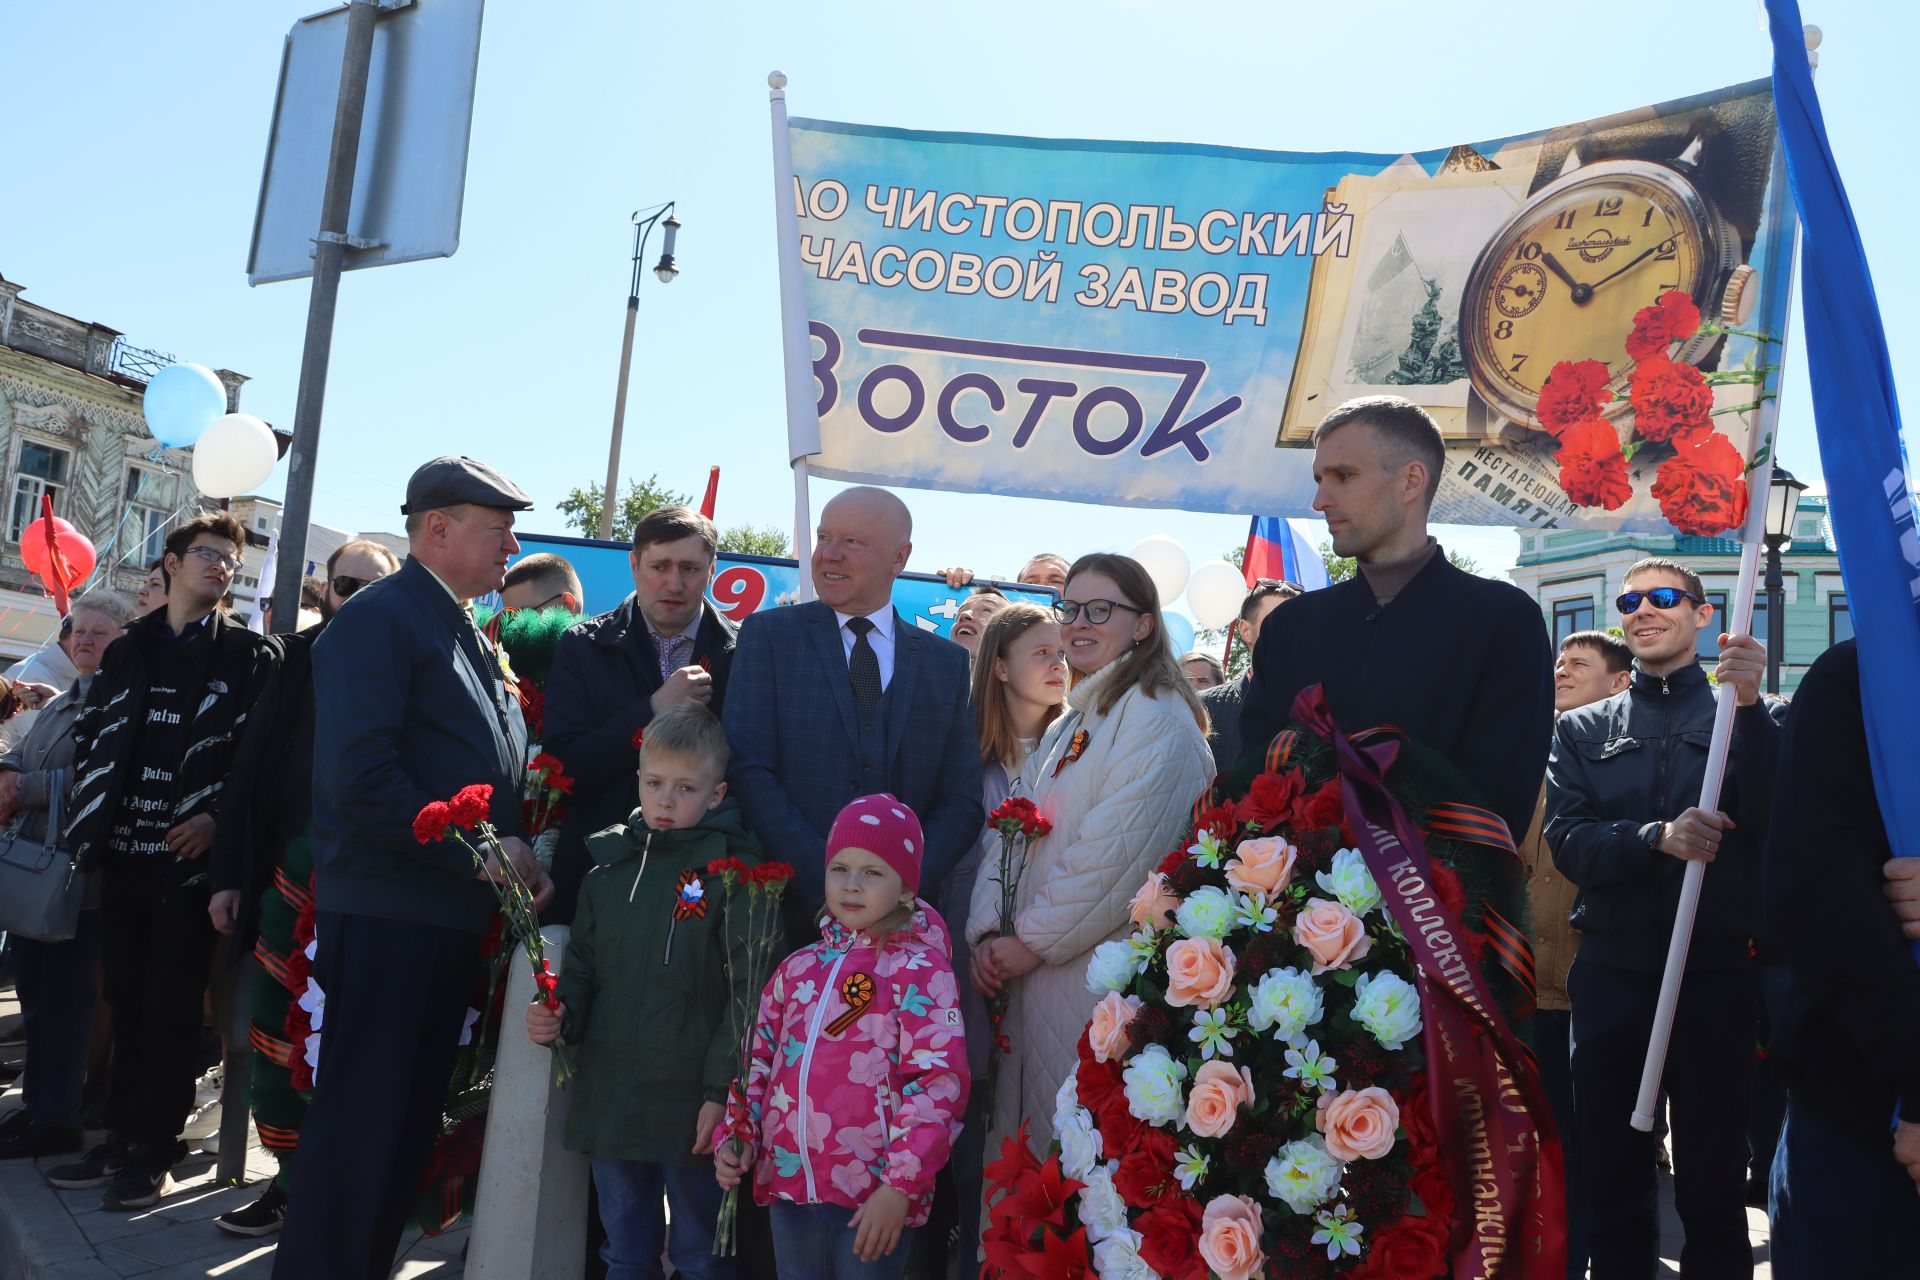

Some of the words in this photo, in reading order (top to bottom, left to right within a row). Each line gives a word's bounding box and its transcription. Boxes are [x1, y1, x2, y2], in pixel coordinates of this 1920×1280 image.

[1593, 196, 1624, 217] 12
[1641, 205, 1655, 228] 1
[865, 184, 1354, 258] ЧИСТОПОЛЬСКИЙ
[1554, 209, 1577, 229] 11
[1515, 241, 1543, 261] 10
[1654, 239, 1677, 261] 2
[801, 234, 1063, 303] ЧАСОВОЙ
[1075, 264, 1270, 326] ЗАВОД
[1494, 320, 1513, 340] 8
[1510, 353, 1528, 373] 7
[1474, 447, 1578, 517] НЕСТАРЕЮЩАЯ
[710, 564, 766, 622] 9
[146, 708, 181, 725] Palm
[141, 766, 173, 782] Palm
[130, 796, 169, 812] Angels
[109, 838, 127, 852] alm
